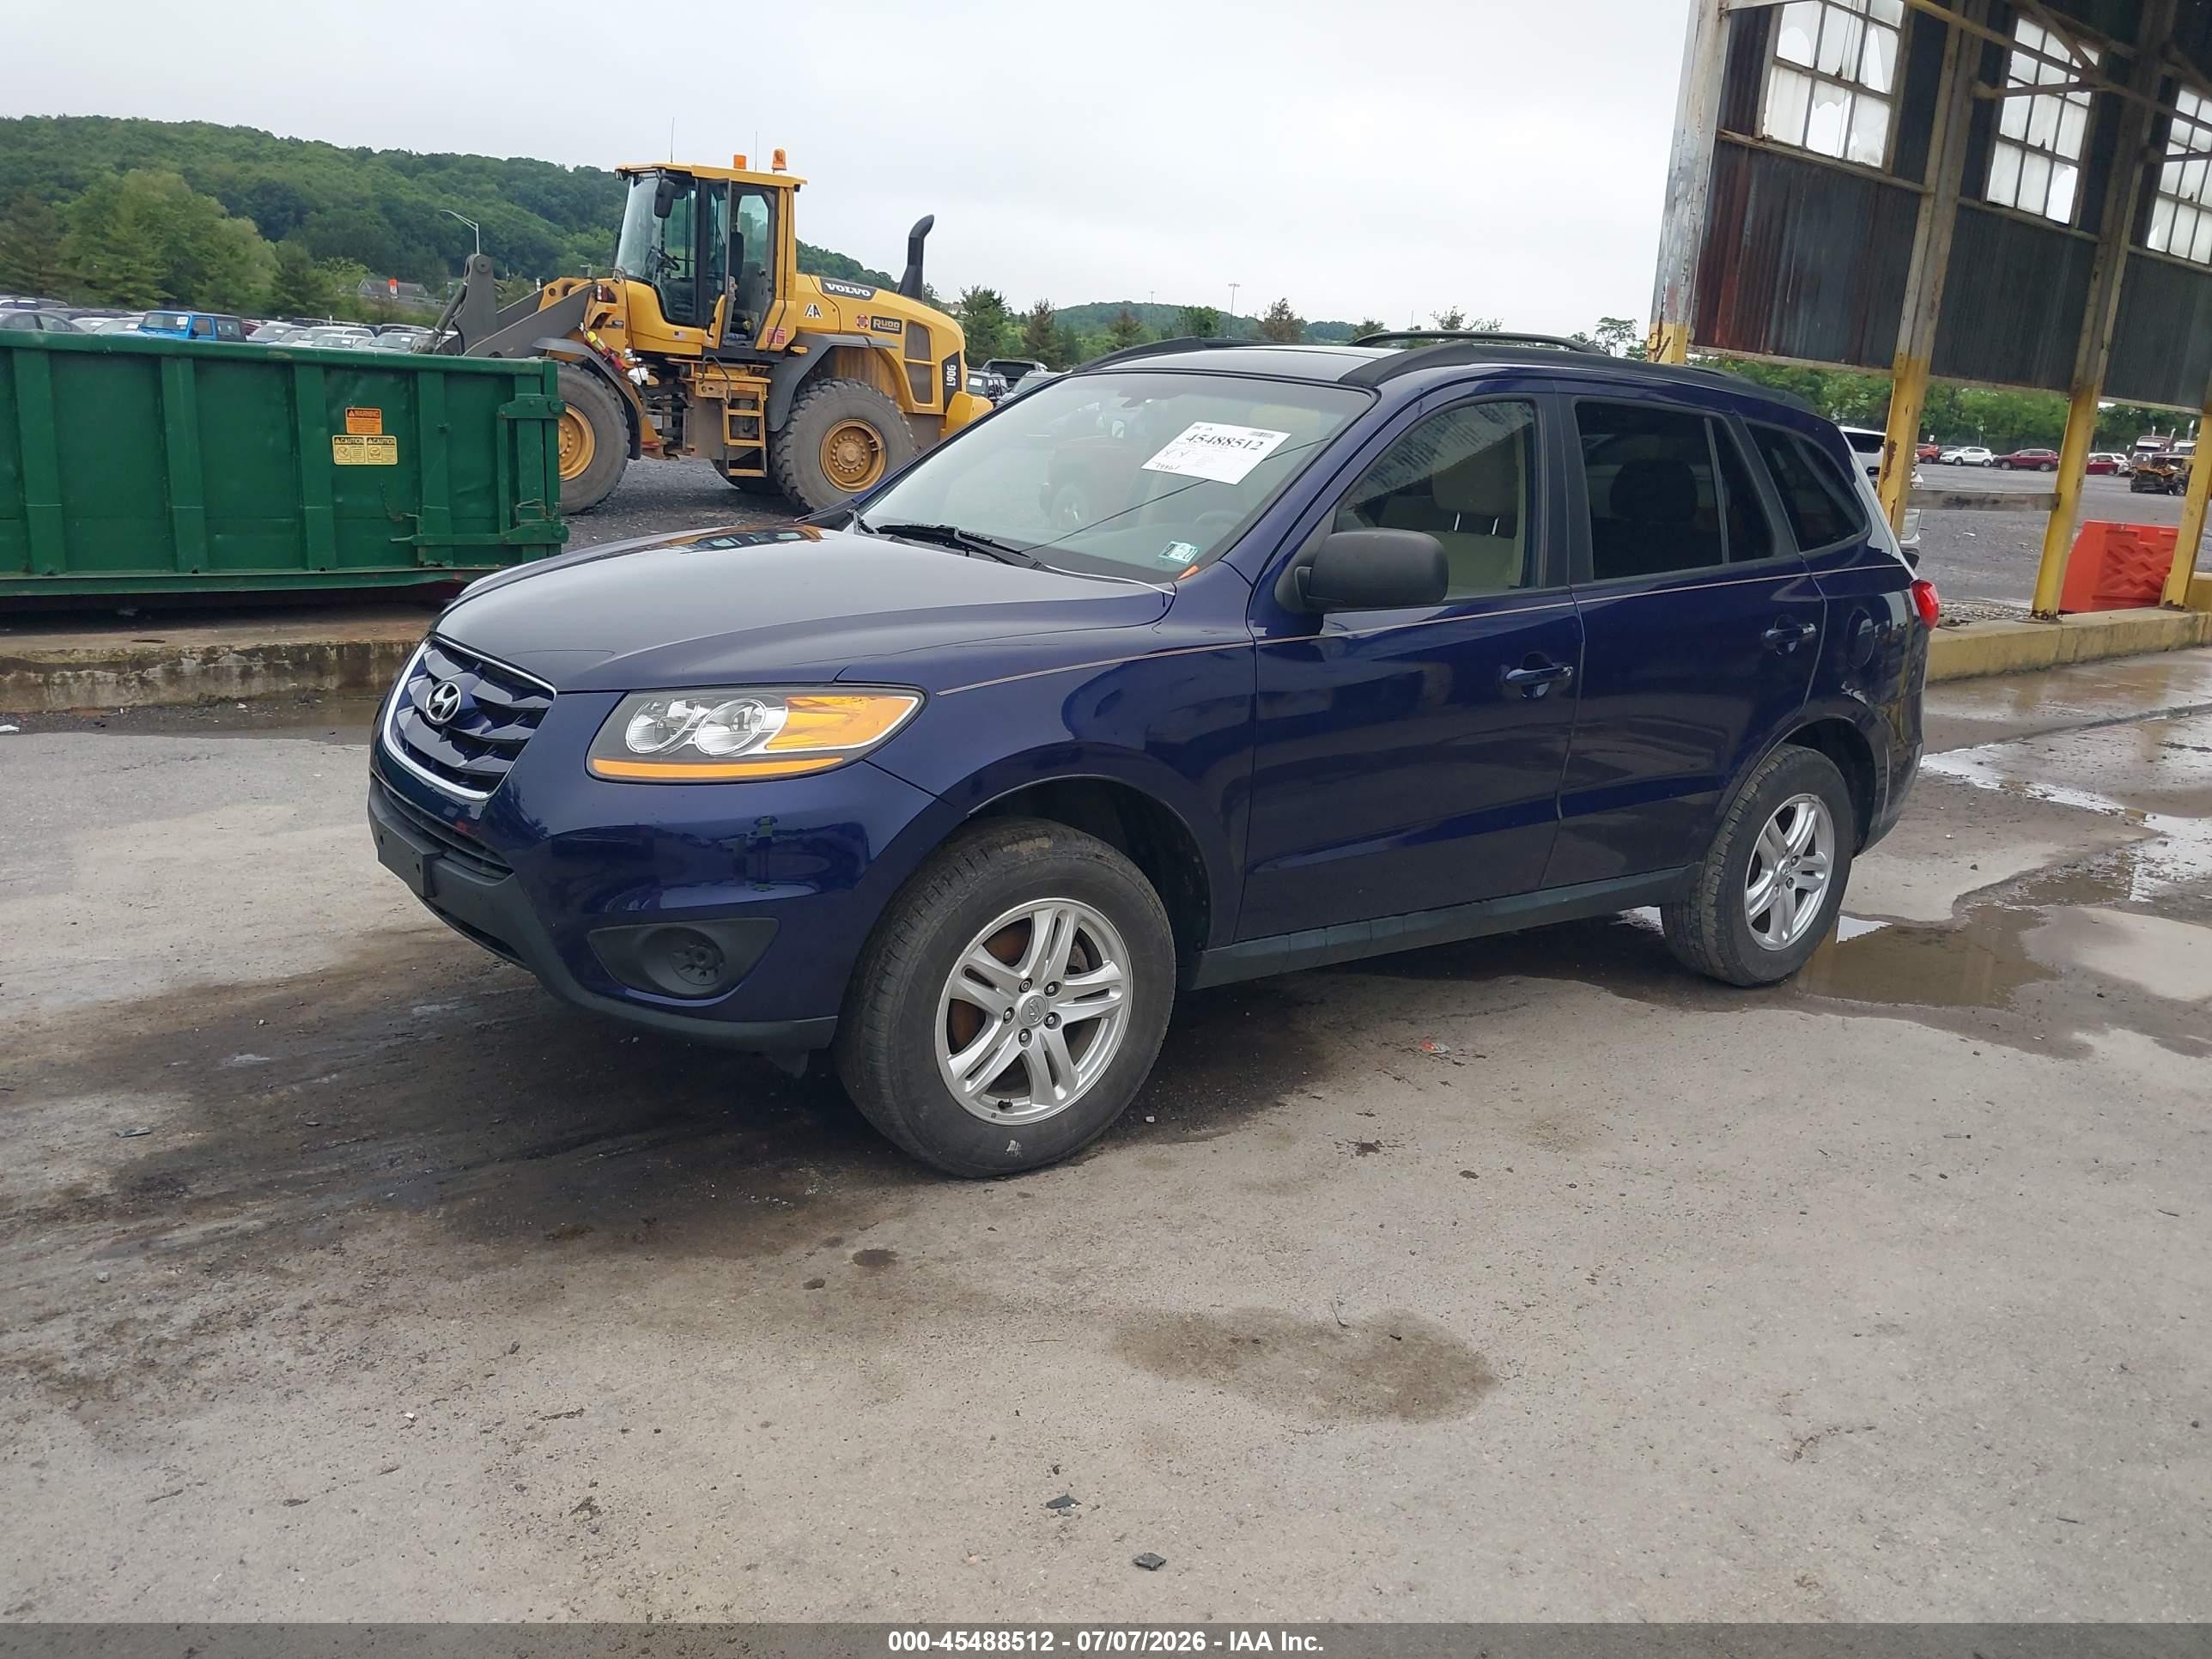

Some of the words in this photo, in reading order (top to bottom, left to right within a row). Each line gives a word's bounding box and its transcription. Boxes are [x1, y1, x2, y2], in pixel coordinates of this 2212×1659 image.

[824, 282, 872, 297] VOLVO
[945, 364, 957, 387] L90G
[1186, 434, 1264, 451] 45488512
